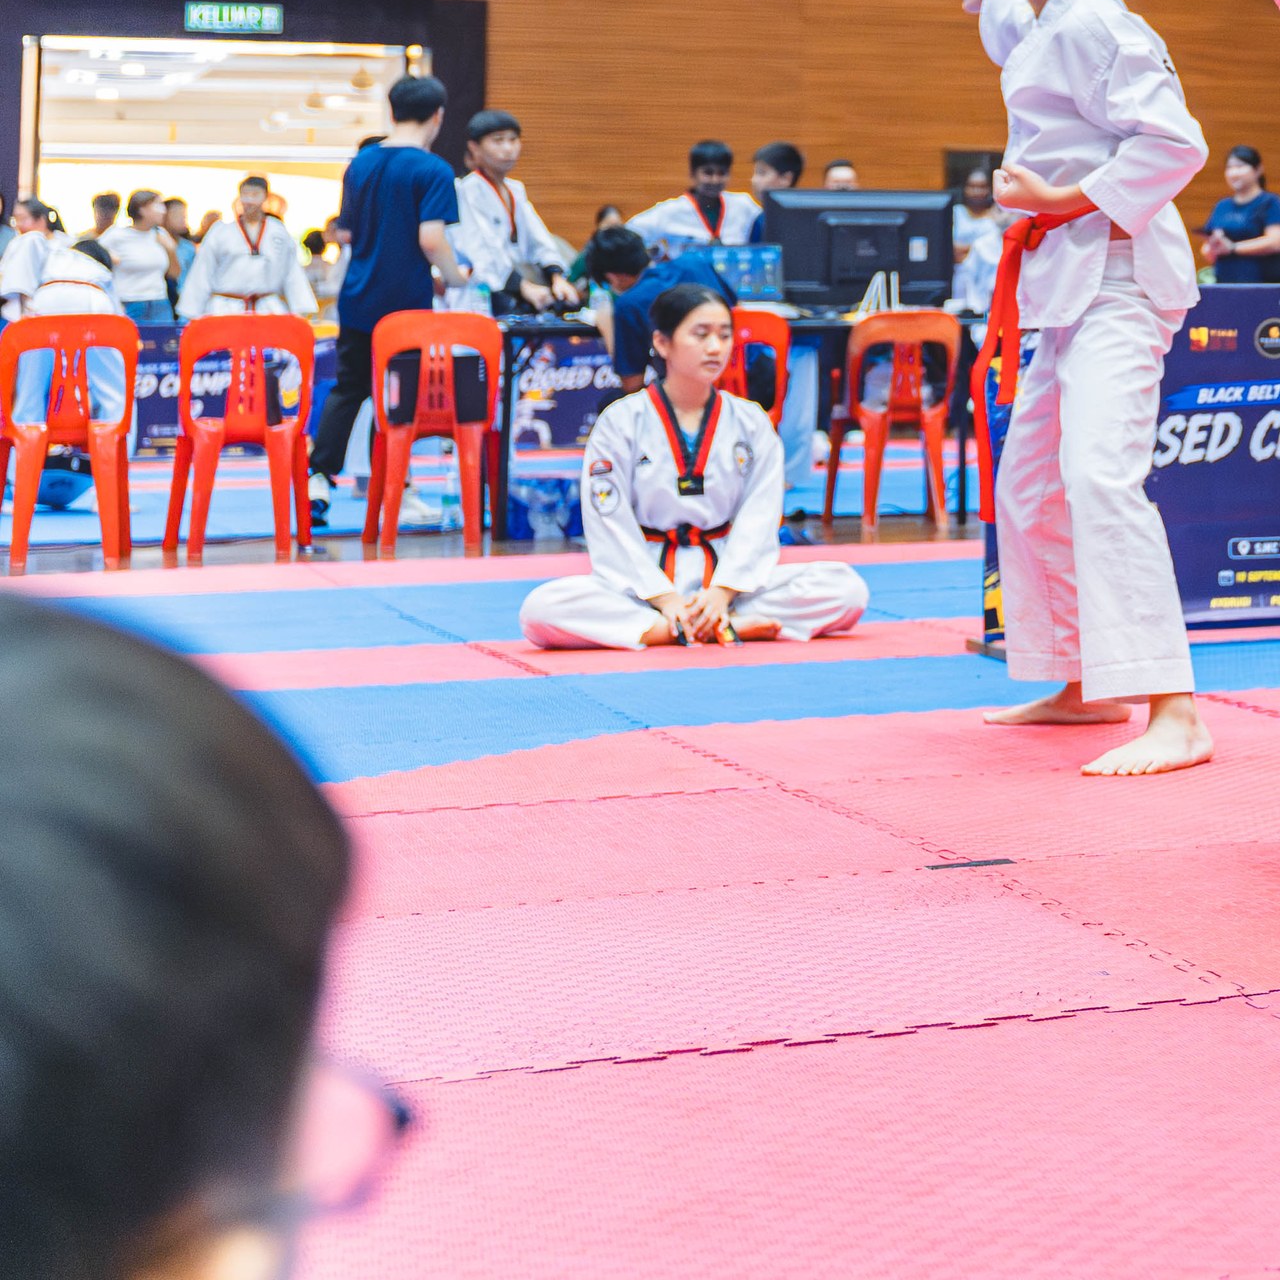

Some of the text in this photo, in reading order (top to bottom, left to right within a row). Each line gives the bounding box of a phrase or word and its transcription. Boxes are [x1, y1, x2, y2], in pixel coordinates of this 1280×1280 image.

[189, 4, 262, 32] KELUAR
[1197, 387, 1245, 405] BLACK
[1152, 410, 1243, 469] SED
